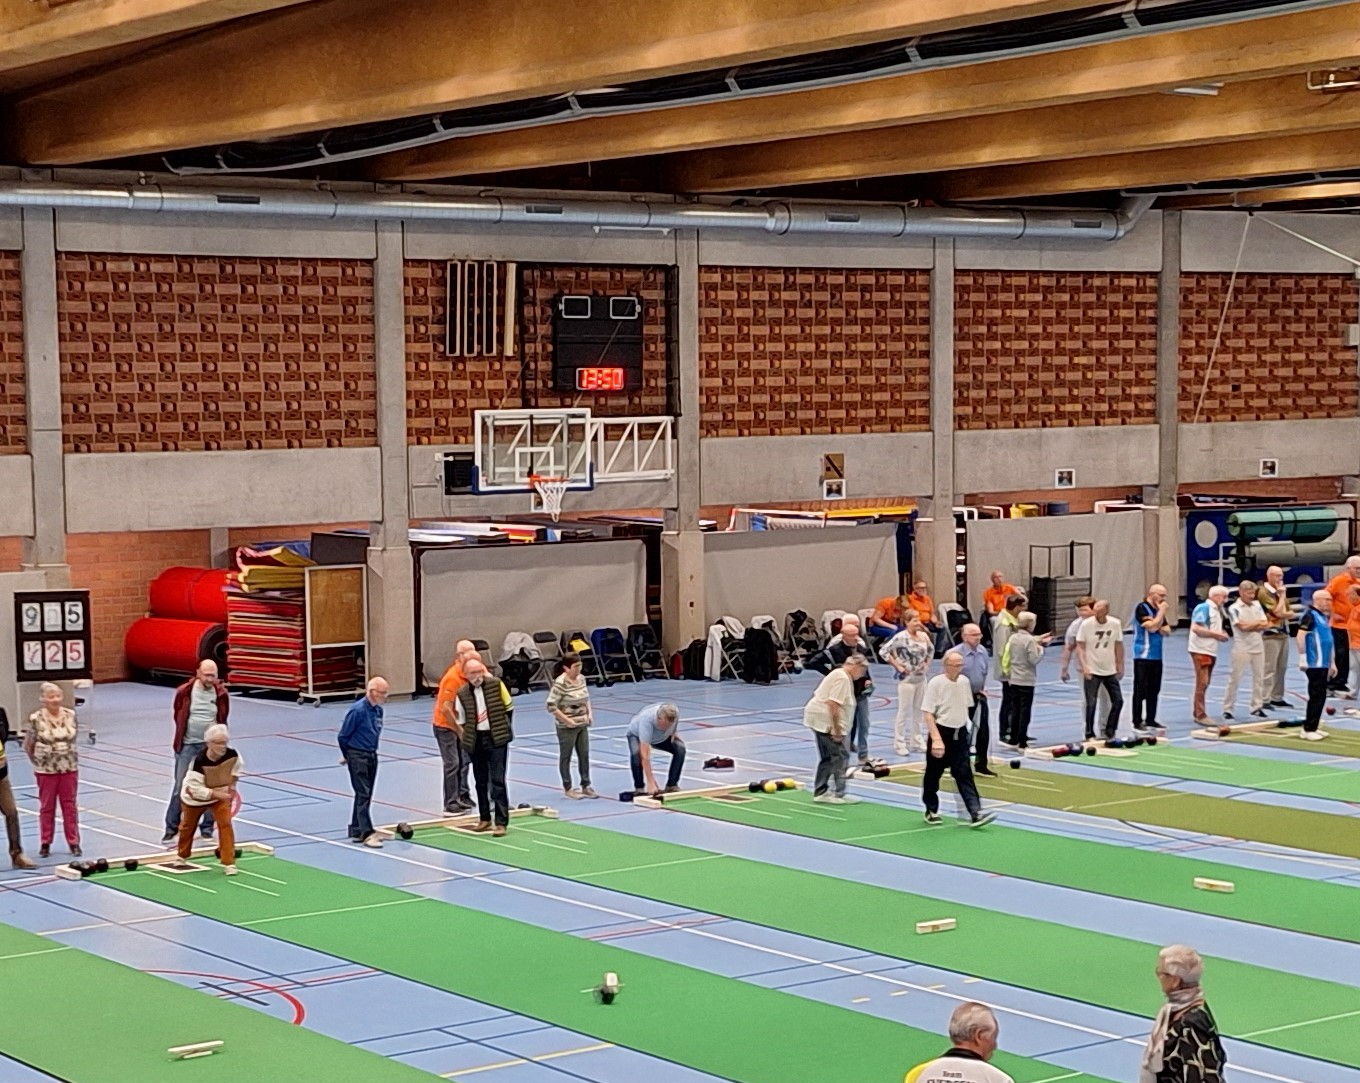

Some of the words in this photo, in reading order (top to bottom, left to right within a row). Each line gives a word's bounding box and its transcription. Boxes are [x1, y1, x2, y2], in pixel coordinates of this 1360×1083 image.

[581, 368, 623, 389] 13:50
[68, 603, 80, 624] 5
[47, 642, 61, 663] 2
[69, 642, 81, 662] 5
